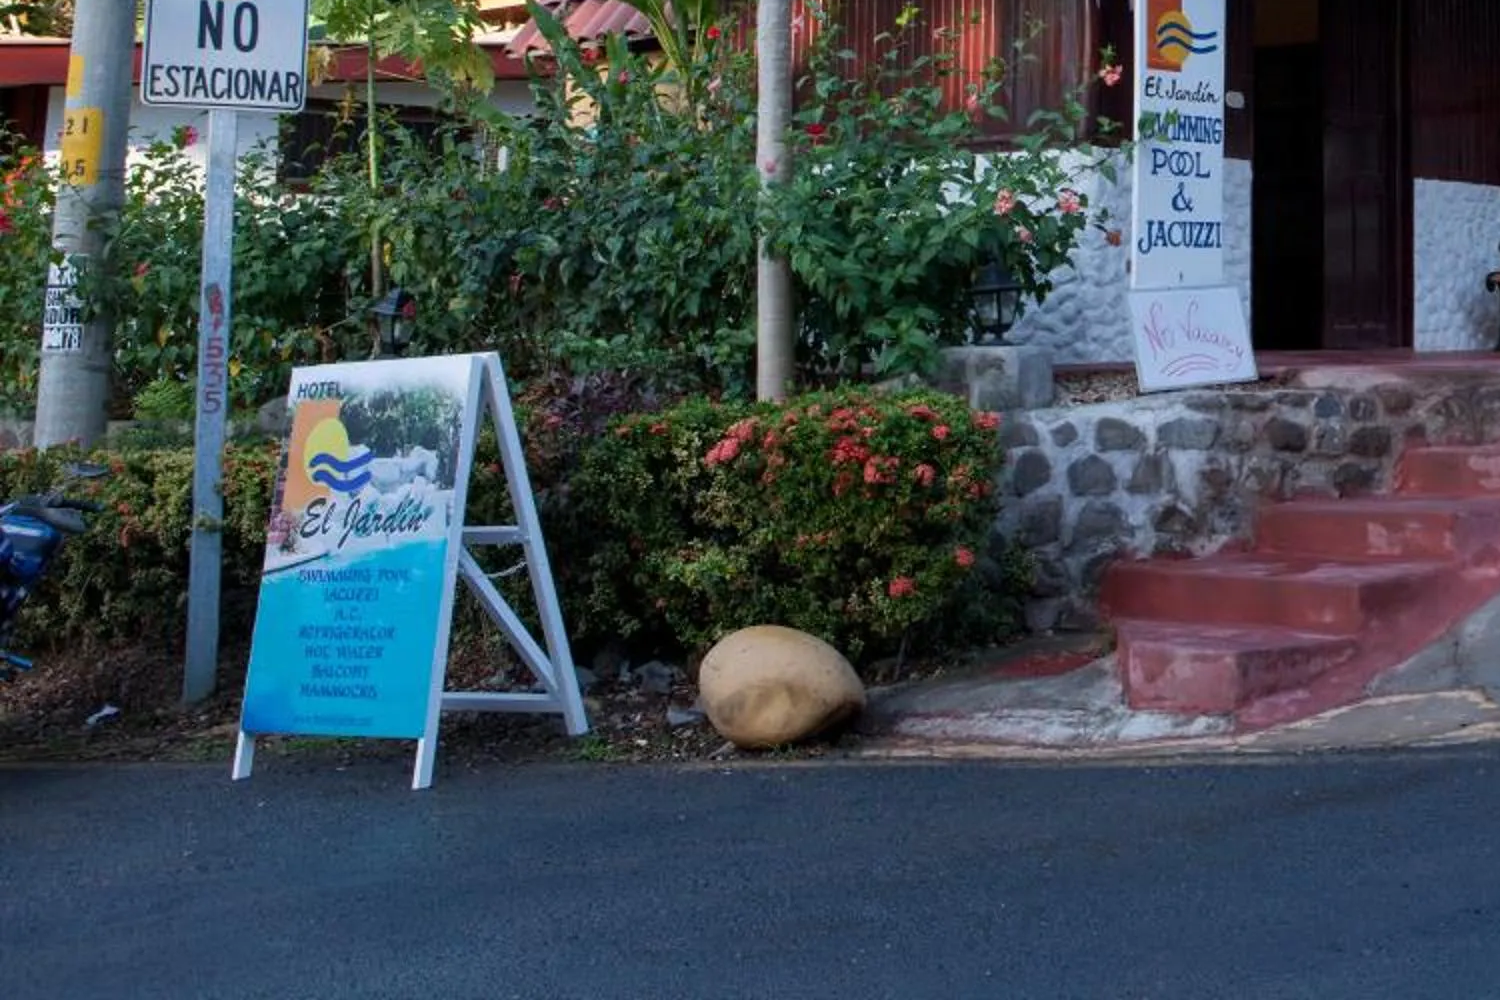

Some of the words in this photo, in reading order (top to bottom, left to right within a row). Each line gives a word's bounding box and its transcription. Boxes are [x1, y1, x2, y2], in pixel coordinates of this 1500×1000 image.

[198, 0, 259, 52] NO
[150, 64, 300, 102] ESTACIONAR
[1145, 76, 1163, 99] El
[1152, 148, 1211, 178] POOL
[1171, 182, 1194, 213] &
[1138, 220, 1222, 254] JACUZZI
[297, 382, 343, 399] HOTEL
[300, 497, 336, 539] El
